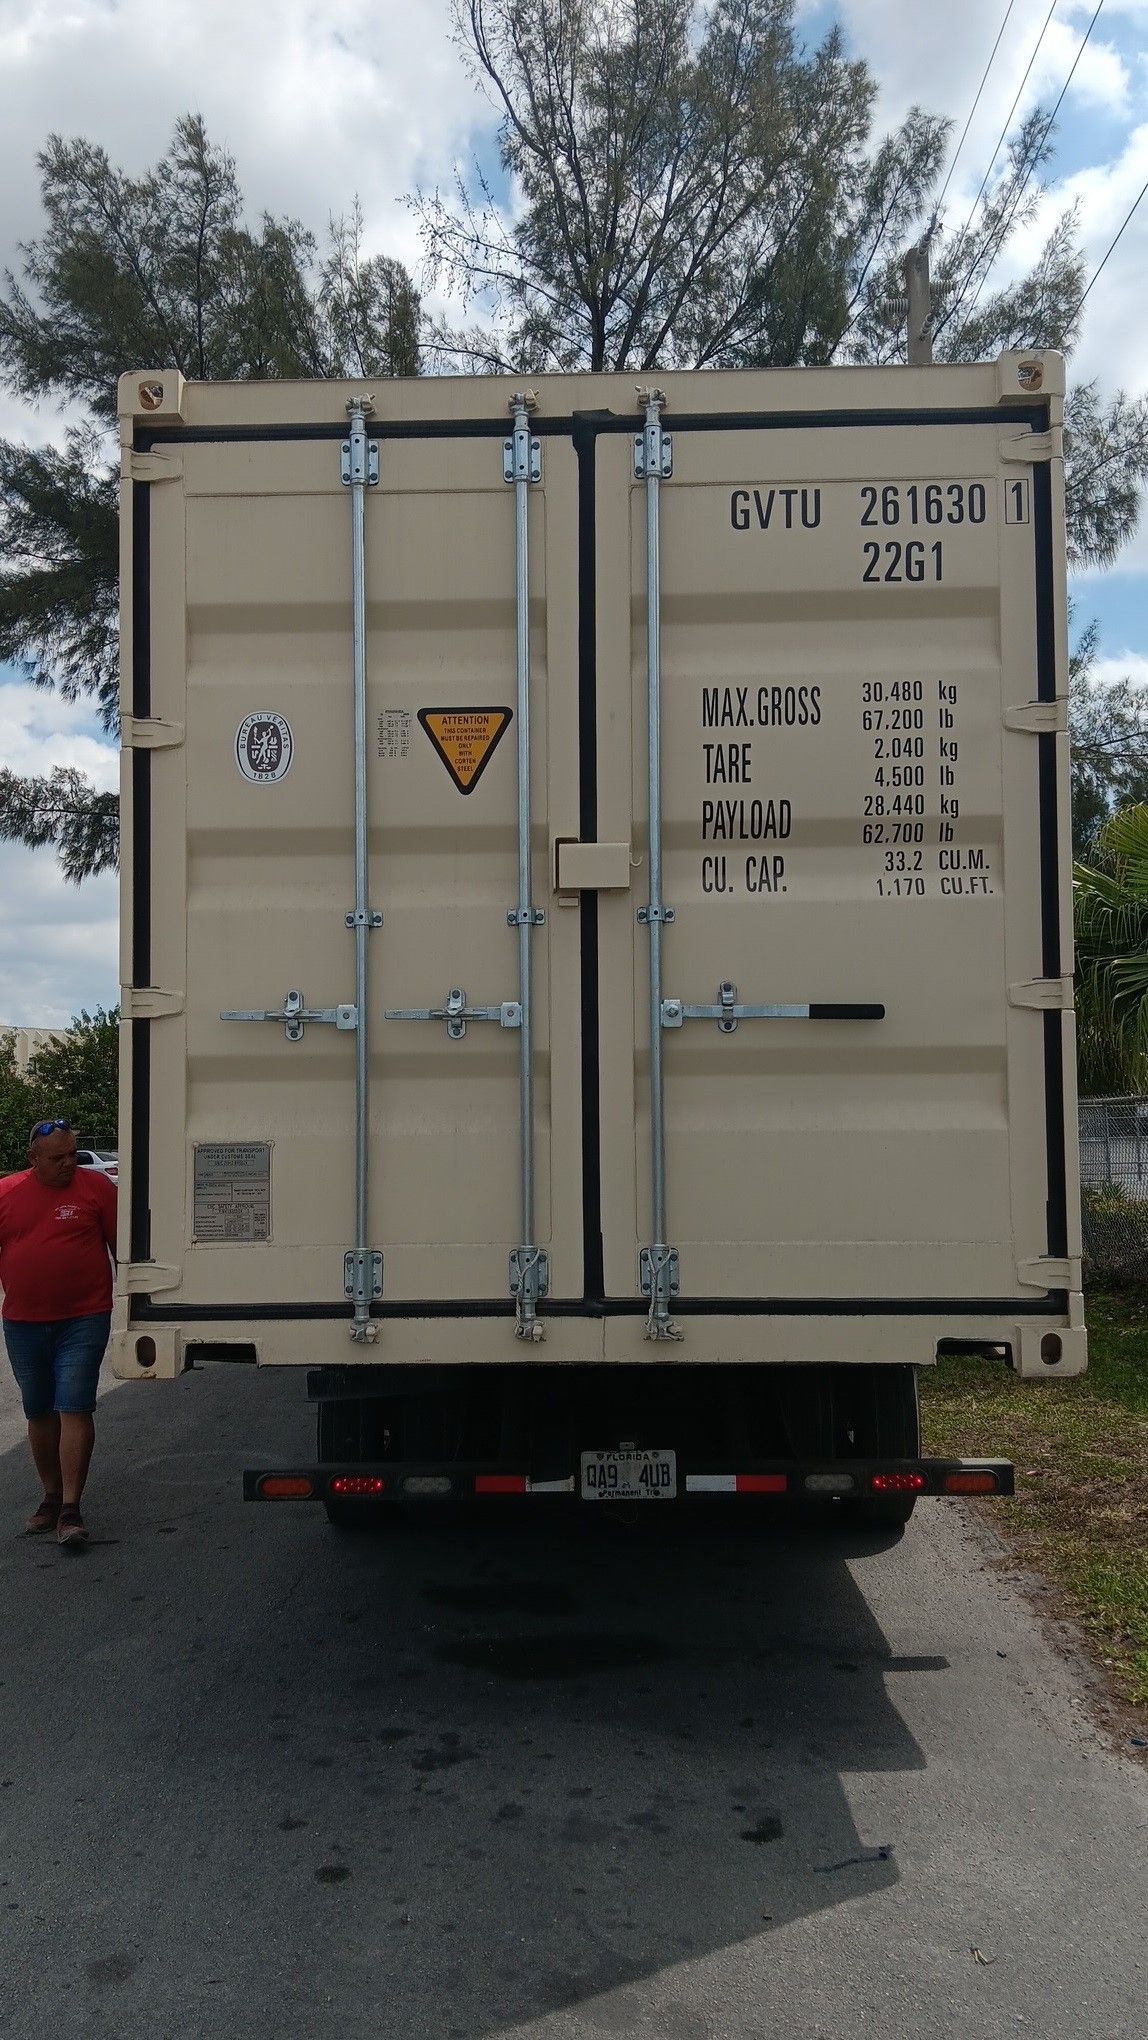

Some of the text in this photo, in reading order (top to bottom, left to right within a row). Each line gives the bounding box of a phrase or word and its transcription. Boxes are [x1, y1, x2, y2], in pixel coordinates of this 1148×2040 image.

[731, 482, 1023, 530] GVTU 261630 1
[863, 541, 943, 582] 22G1
[703, 686, 821, 726] MAX.GROSS
[939, 680, 957, 704] kg
[442, 715, 489, 725] ATTENTION
[939, 708, 954, 729] lb
[240, 715, 289, 749] BUREAU VERITAS
[703, 743, 752, 783] TARE
[939, 737, 958, 761] kg
[253, 772, 276, 780] 1828
[940, 765, 954, 786] lb
[703, 800, 792, 840] PAYLOAD
[940, 794, 959, 819] kg
[939, 822, 954, 843] lb
[702, 849, 990, 893] CU. CAP. 33.2 CU.M.
[941, 876, 994, 896] CU.FT.
[606, 1453, 650, 1461] FLORIDA
[587, 1463, 671, 1488] QA9 4UB
